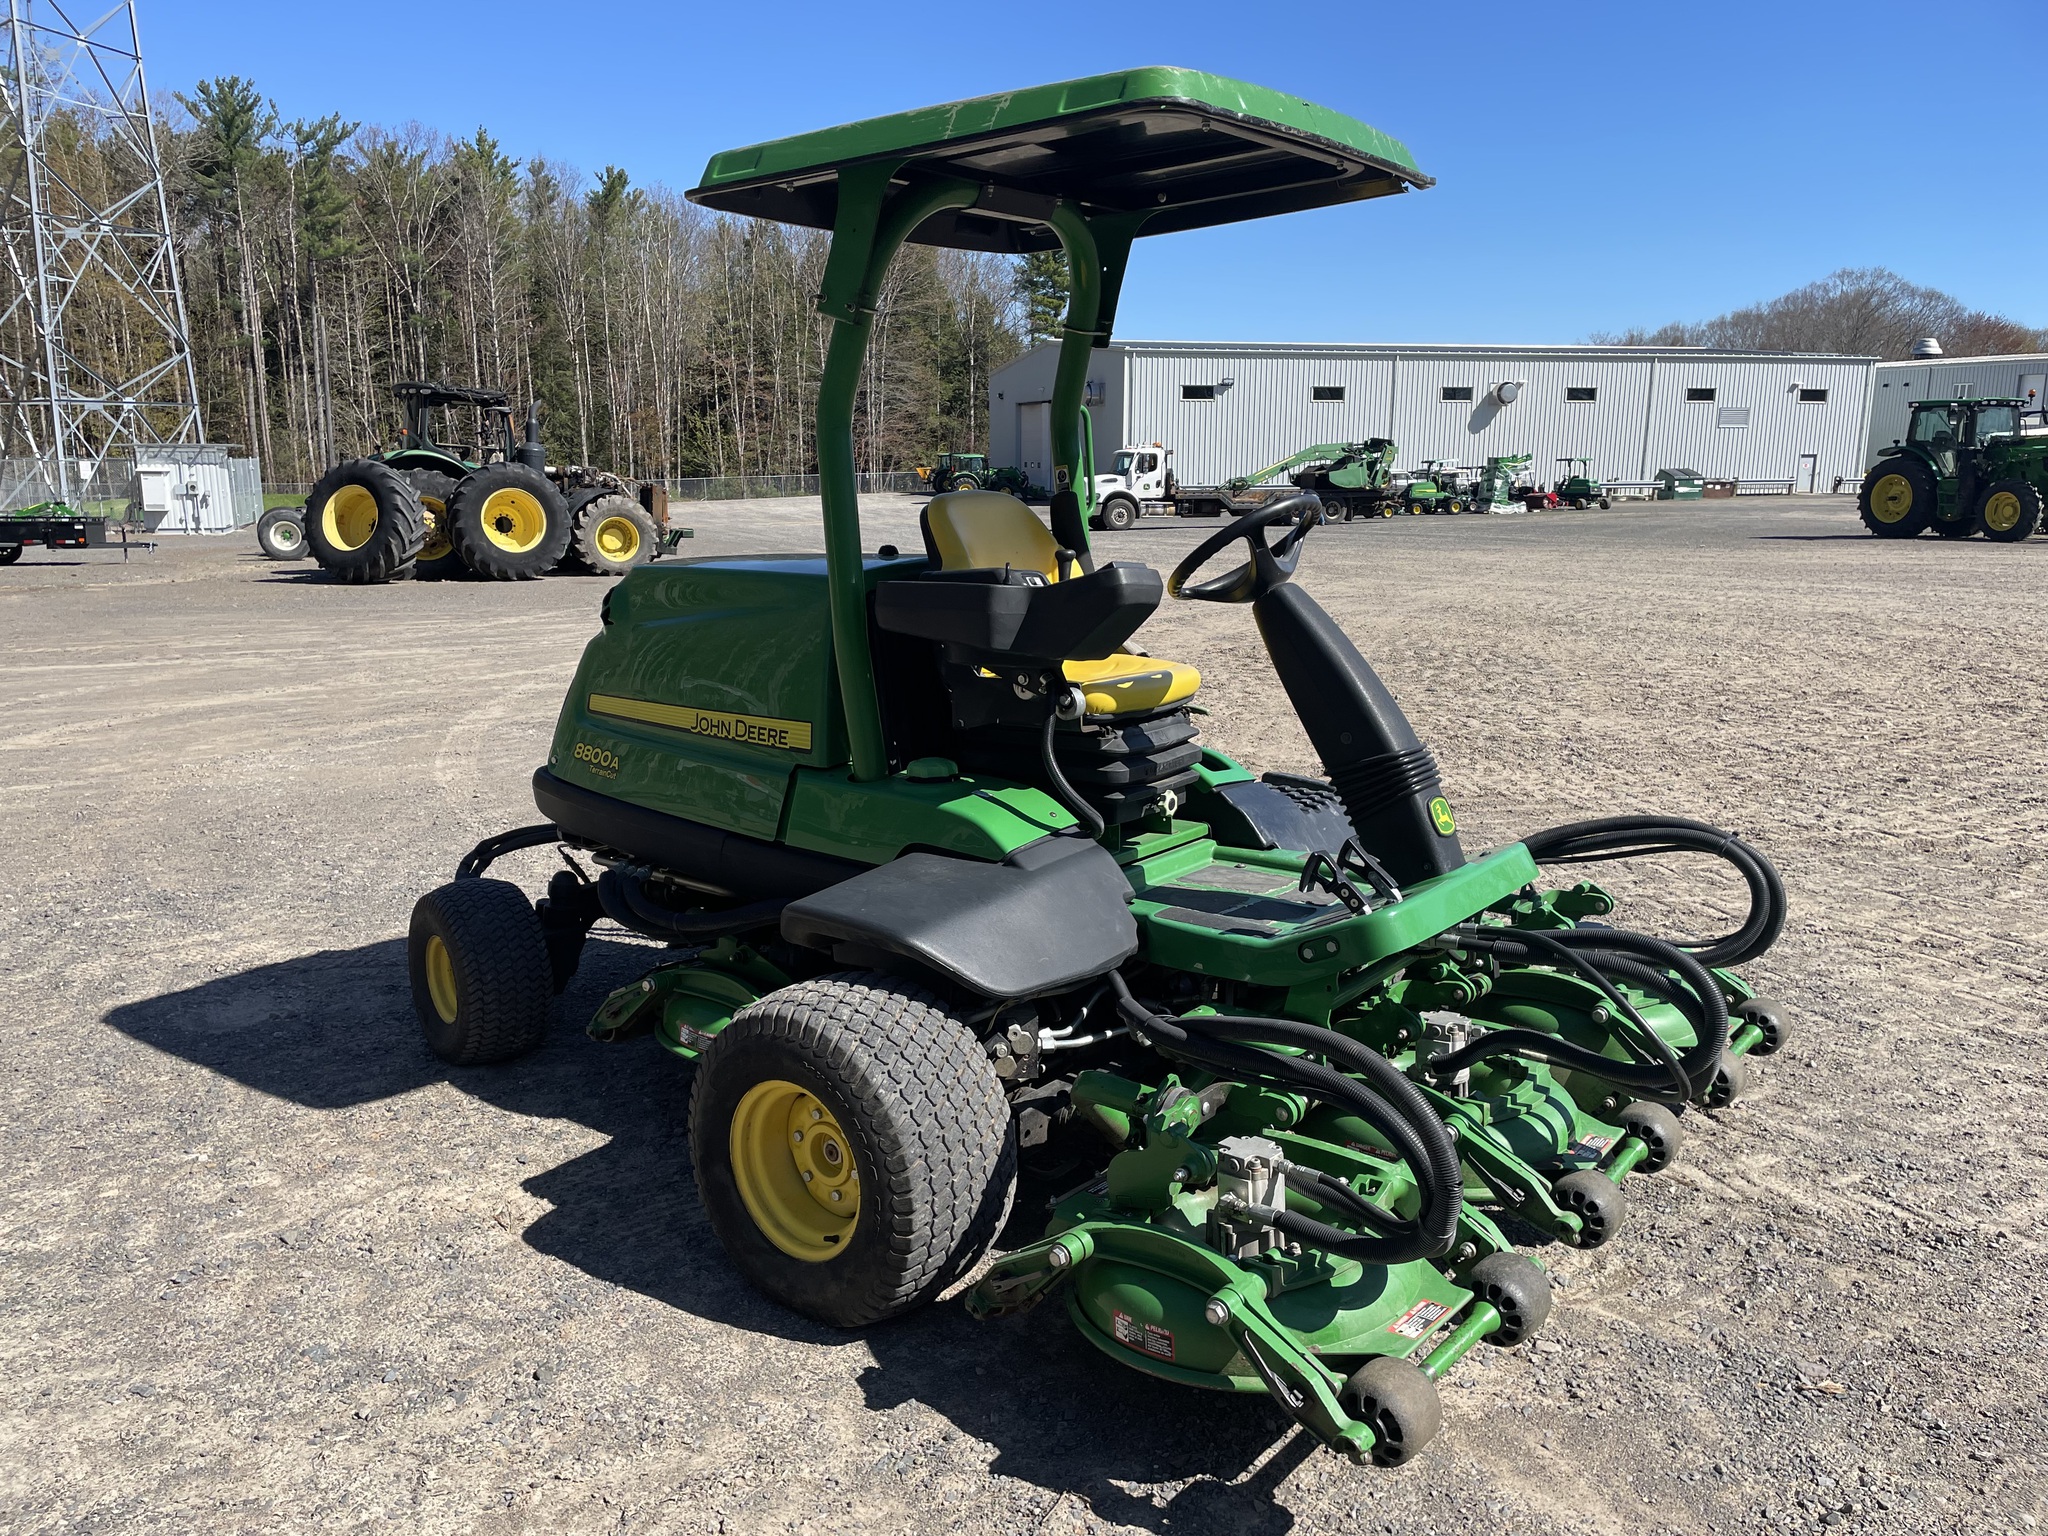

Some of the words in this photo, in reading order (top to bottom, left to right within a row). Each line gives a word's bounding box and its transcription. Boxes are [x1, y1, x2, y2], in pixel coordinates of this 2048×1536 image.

[690, 712, 731, 738] JOHN
[735, 718, 789, 746] DEERE
[573, 742, 619, 771] 8800A
